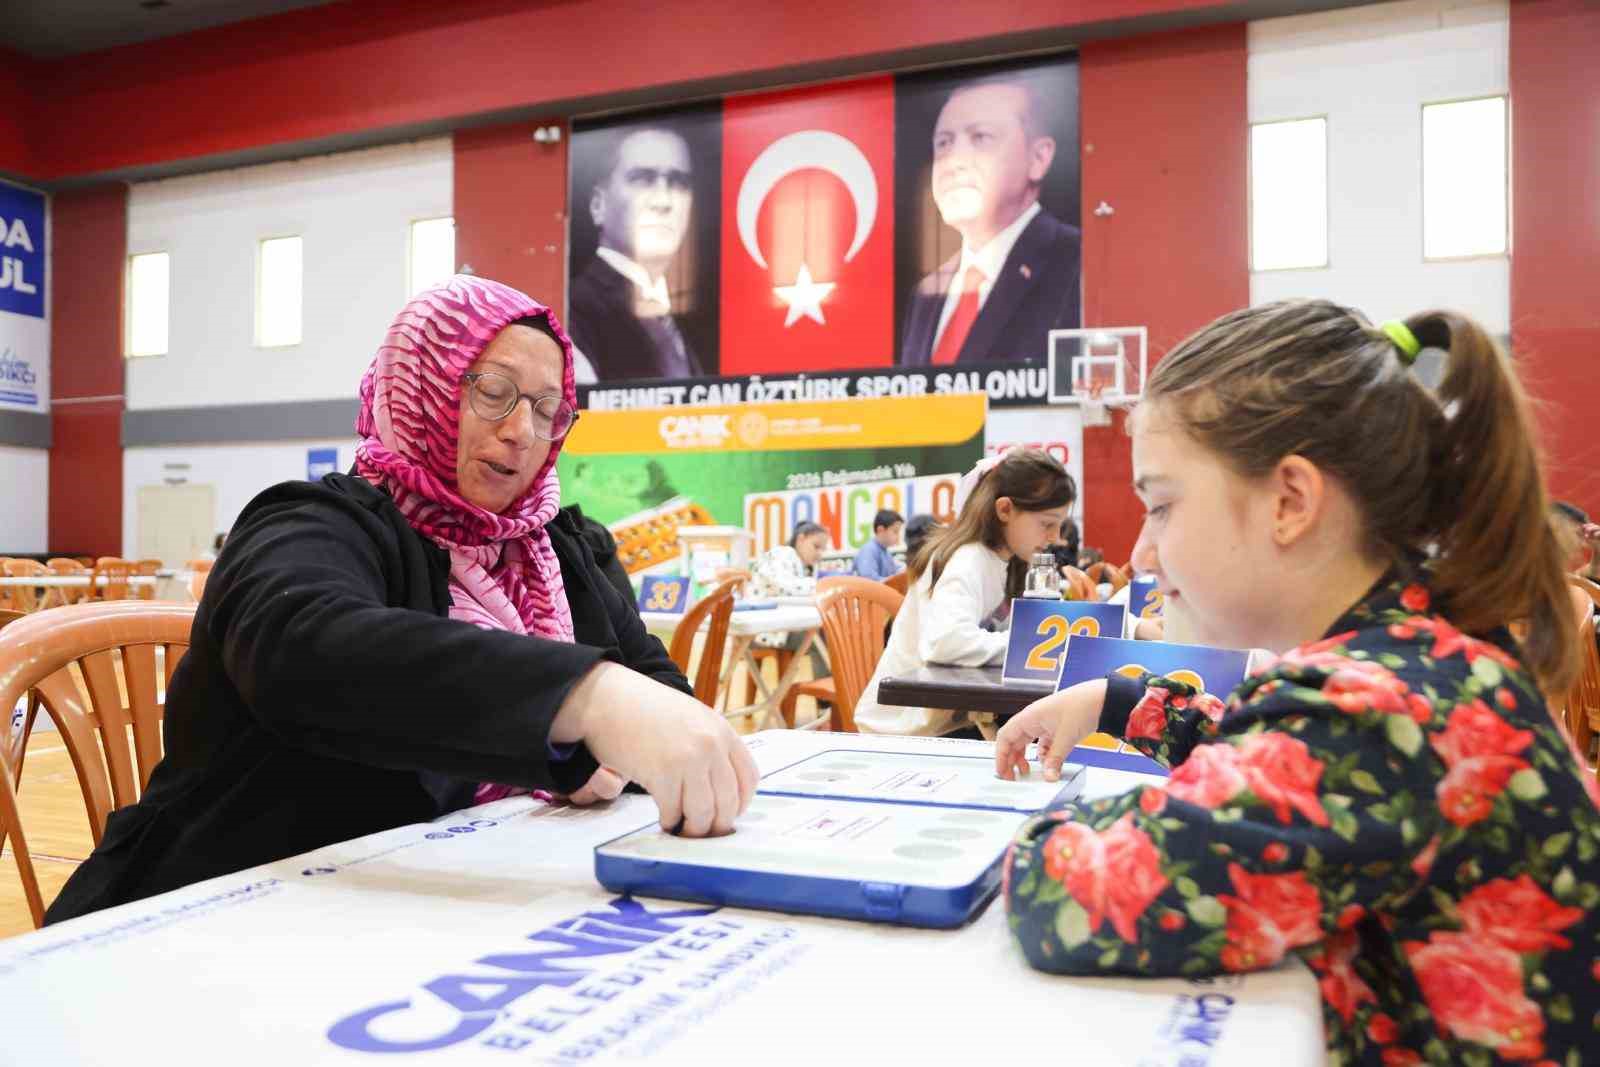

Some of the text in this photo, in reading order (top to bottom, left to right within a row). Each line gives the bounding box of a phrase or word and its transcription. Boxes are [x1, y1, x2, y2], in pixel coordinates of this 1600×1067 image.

[588, 368, 1048, 410] MEHMET CAN ÖZTÜRK SPOR SALONU
[1024, 613, 1101, 672] 2
